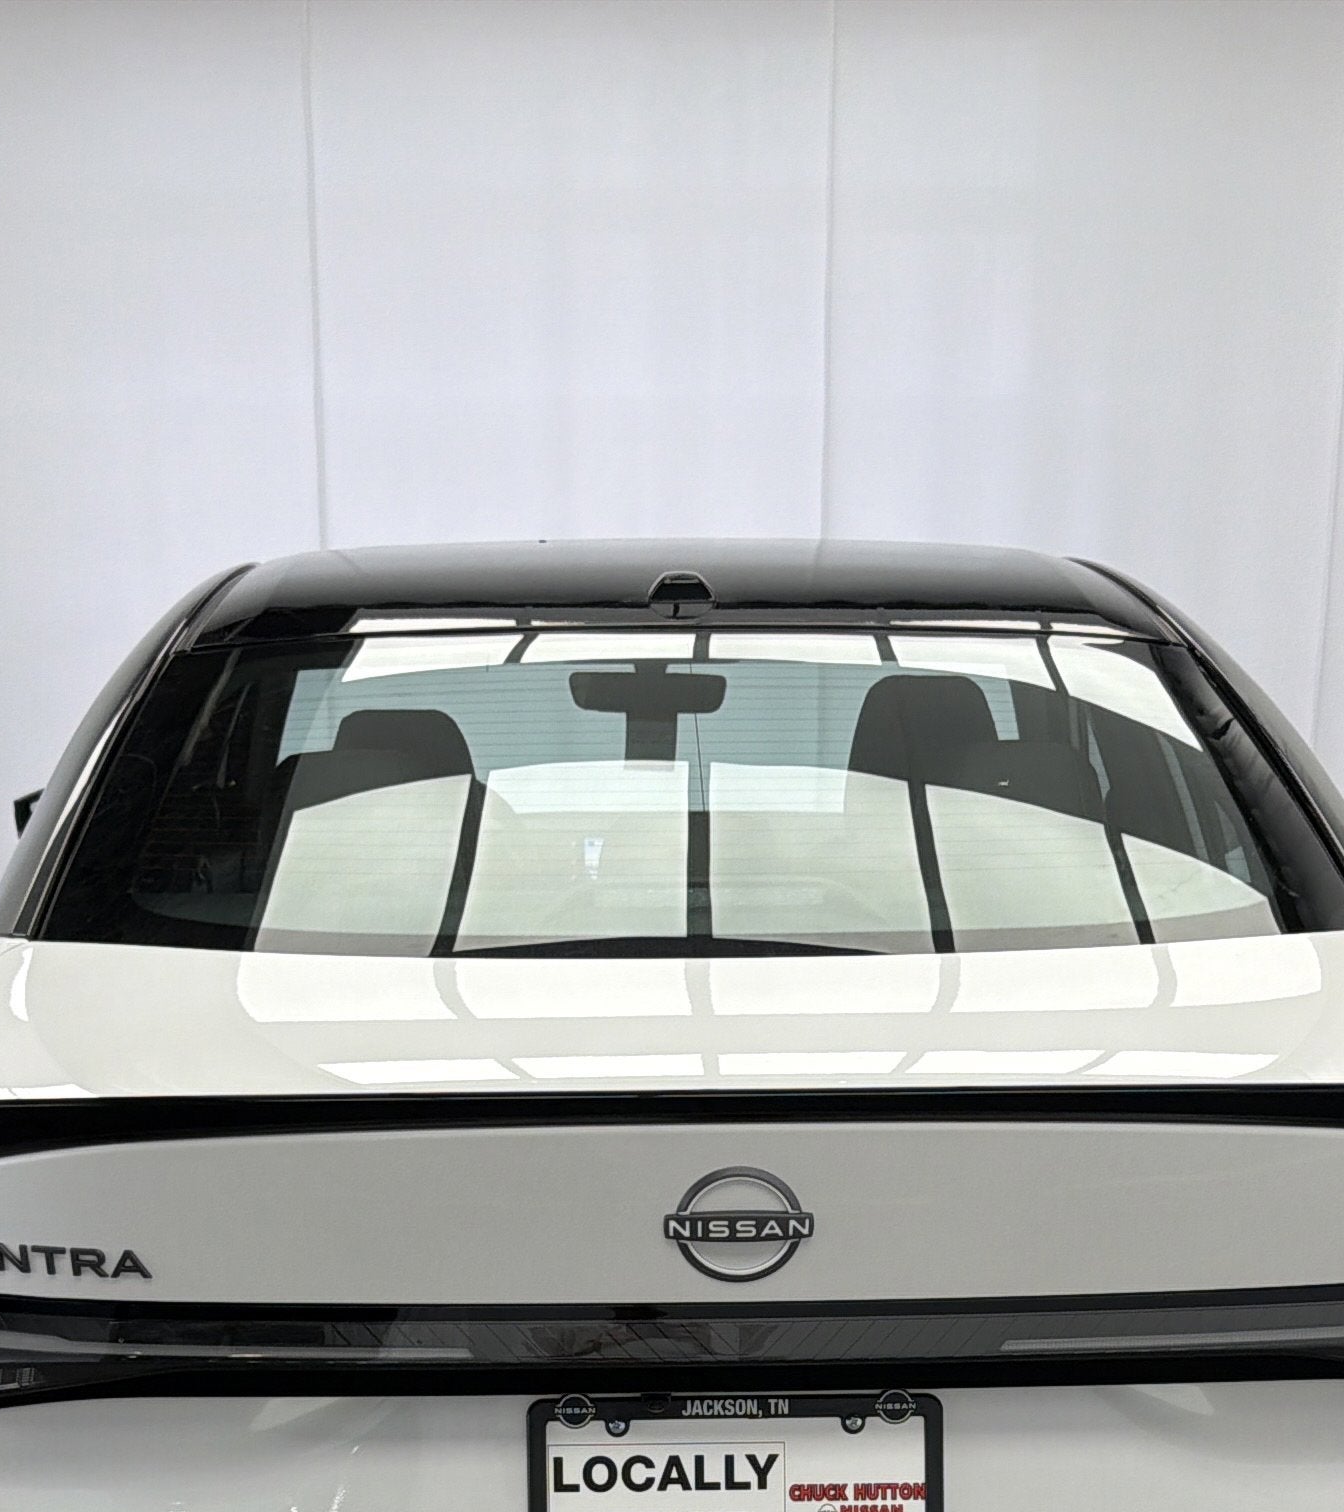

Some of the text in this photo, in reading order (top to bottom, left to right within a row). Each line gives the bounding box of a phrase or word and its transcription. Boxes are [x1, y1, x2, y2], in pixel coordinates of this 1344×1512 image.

[668, 1219, 810, 1237] NISSAN
[681, 1398, 789, 1418] JACKSON, TN
[552, 1453, 779, 1493] LOCALLY
[788, 1482, 928, 1502] CHUCK HUTTON
